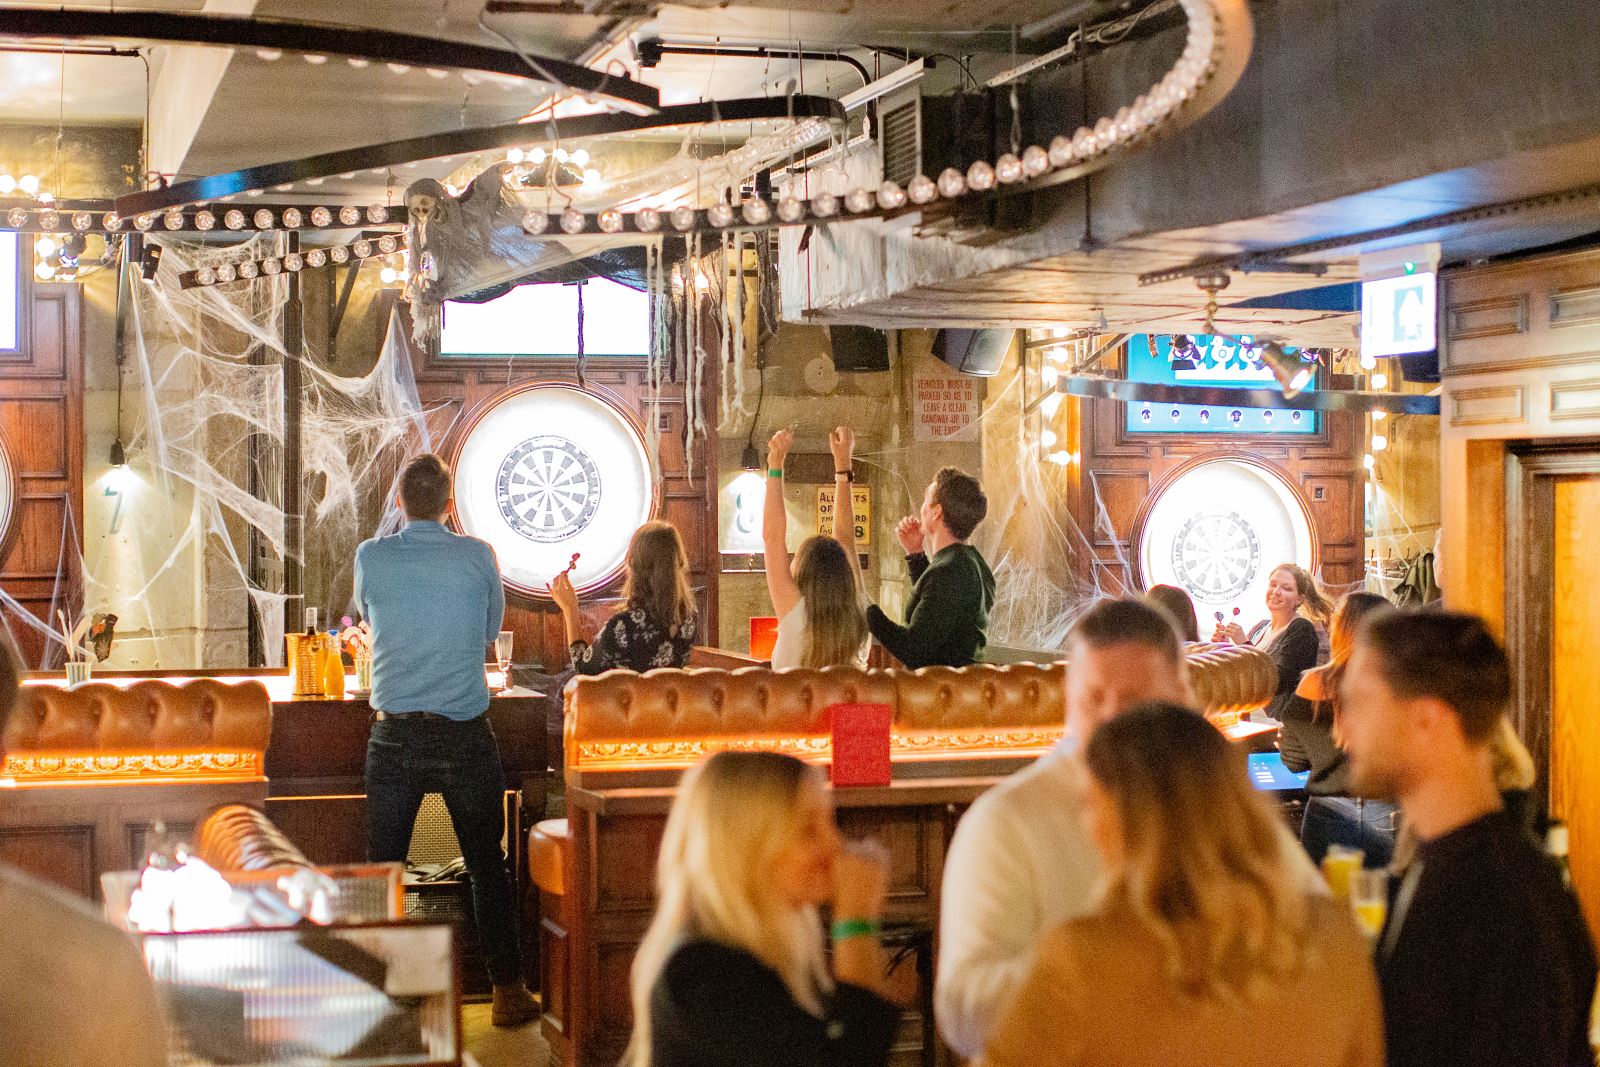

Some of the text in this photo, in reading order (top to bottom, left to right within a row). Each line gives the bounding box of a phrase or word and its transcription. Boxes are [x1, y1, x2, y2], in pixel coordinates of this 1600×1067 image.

[917, 379, 945, 389] VEHICLES
[947, 379, 963, 389] MUST
[917, 391, 972, 400] PARKED SO AS TO
[923, 402, 940, 412] LEAVE
[948, 402, 967, 412] CLEAR
[921, 414, 970, 423] GANGWAY UP TO
[930, 425, 942, 436] THE
[820, 505, 833, 513] OF
